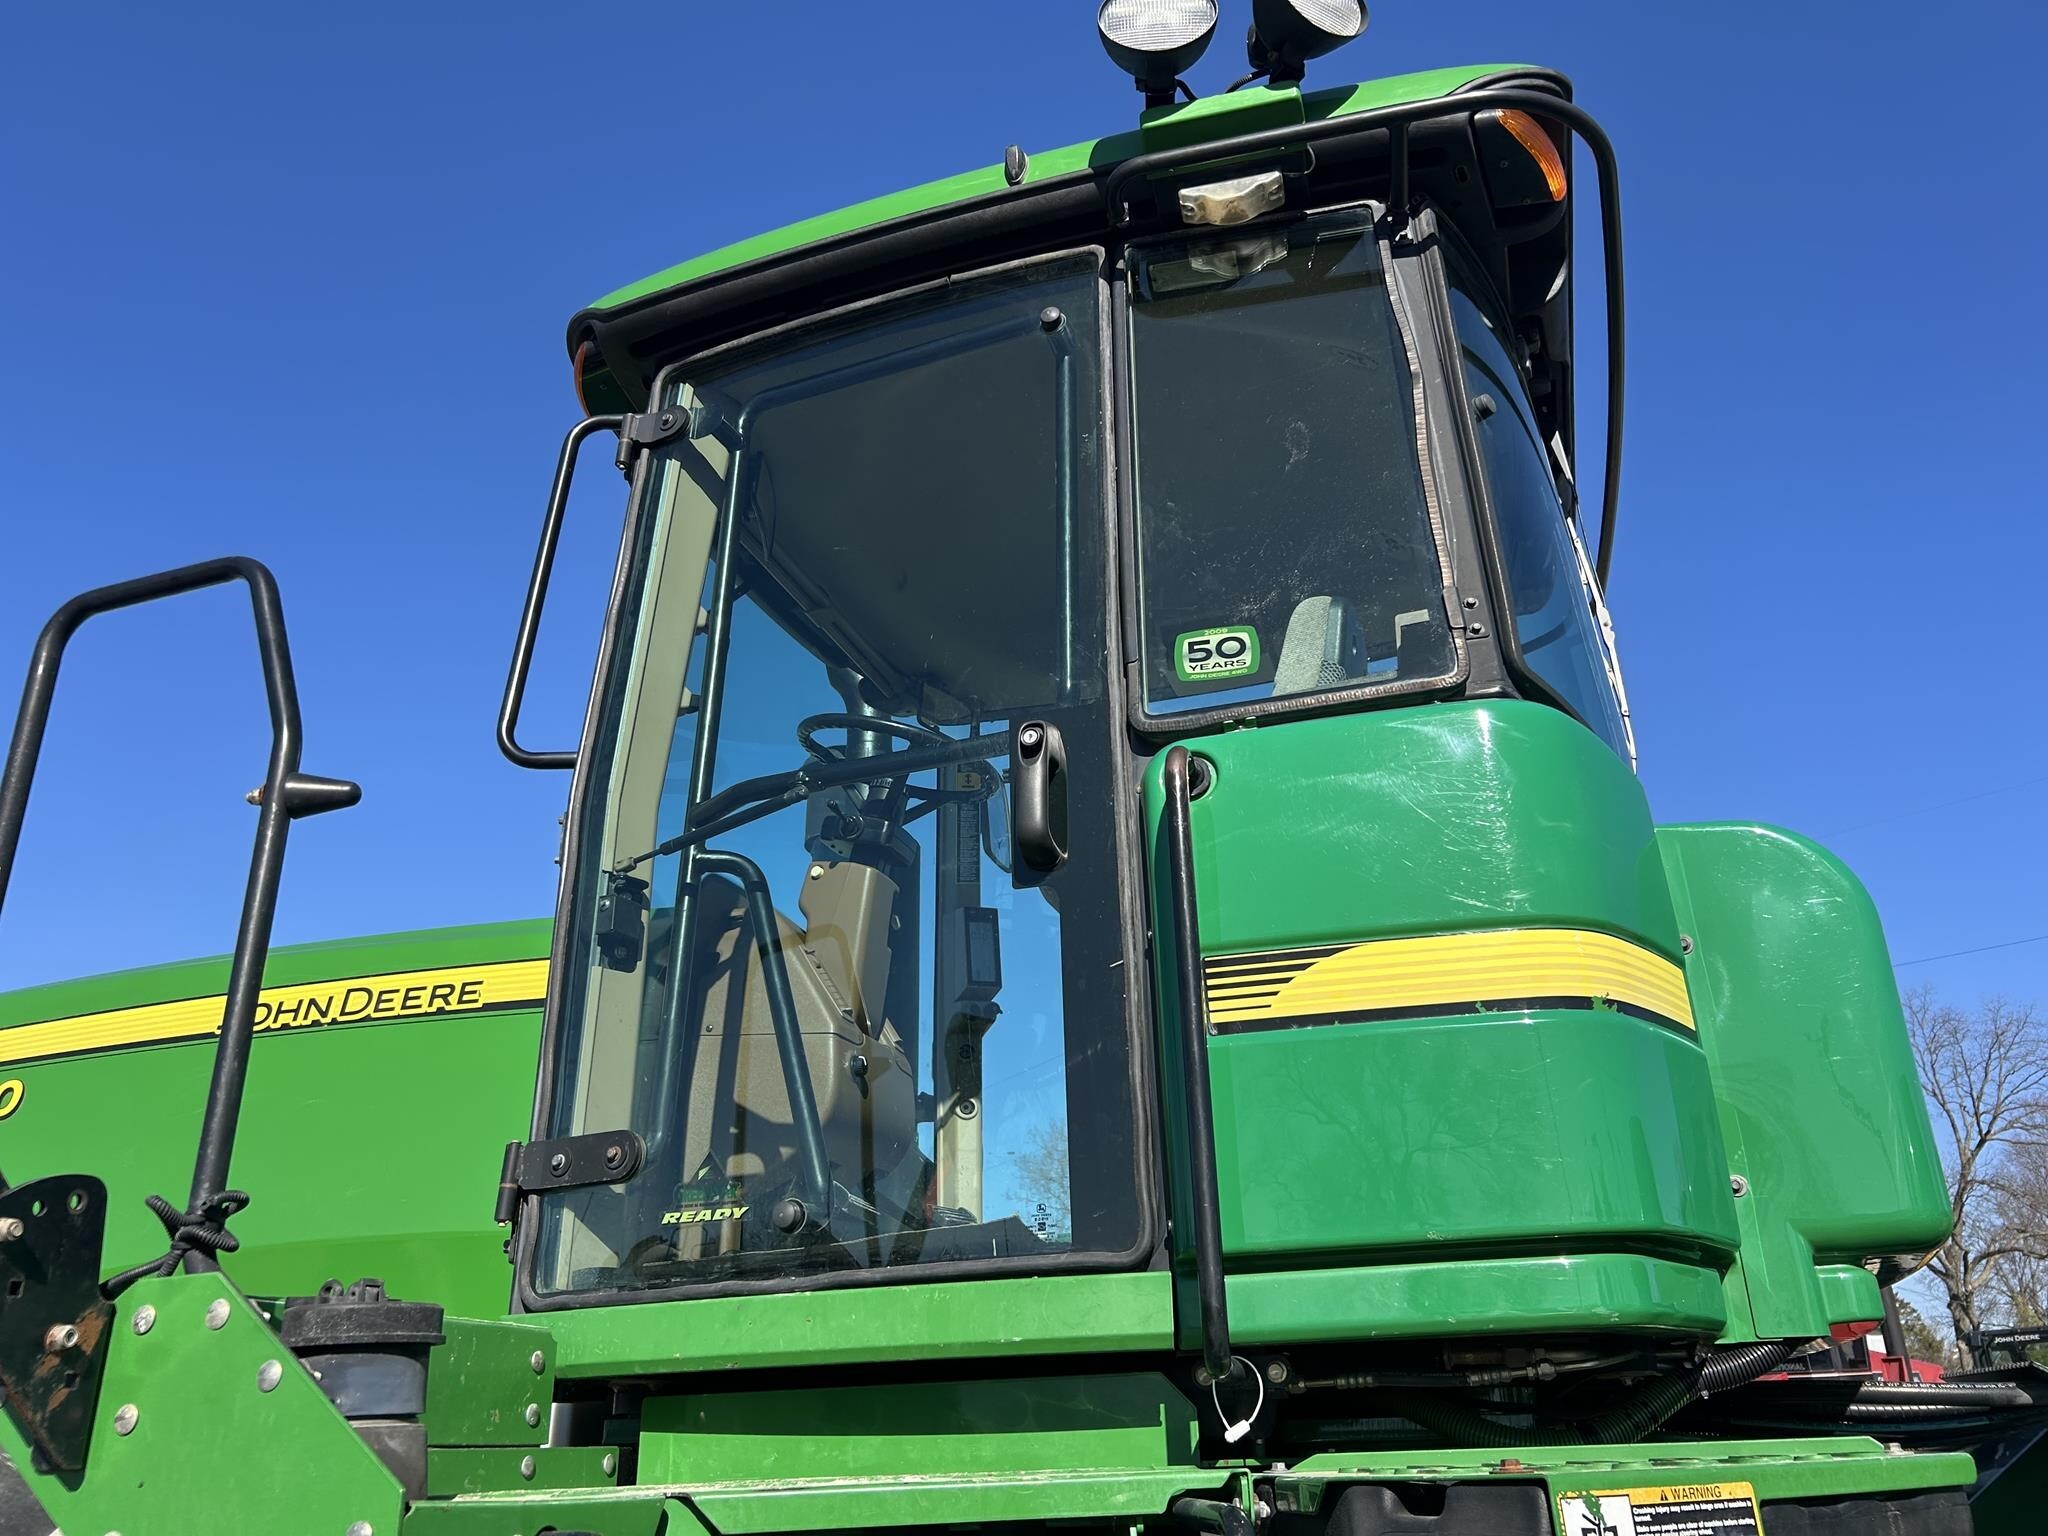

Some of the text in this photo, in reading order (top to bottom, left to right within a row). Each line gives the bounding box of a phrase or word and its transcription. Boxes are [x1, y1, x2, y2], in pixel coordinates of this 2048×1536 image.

[1187, 636, 1247, 663] 50
[1188, 659, 1247, 672] YEARS
[250, 980, 484, 1027] OHN DEERE
[661, 1206, 750, 1225] READY
[1994, 1334, 2041, 1344] JOHN DEERE
[1670, 1486, 1722, 1501] WARNING
